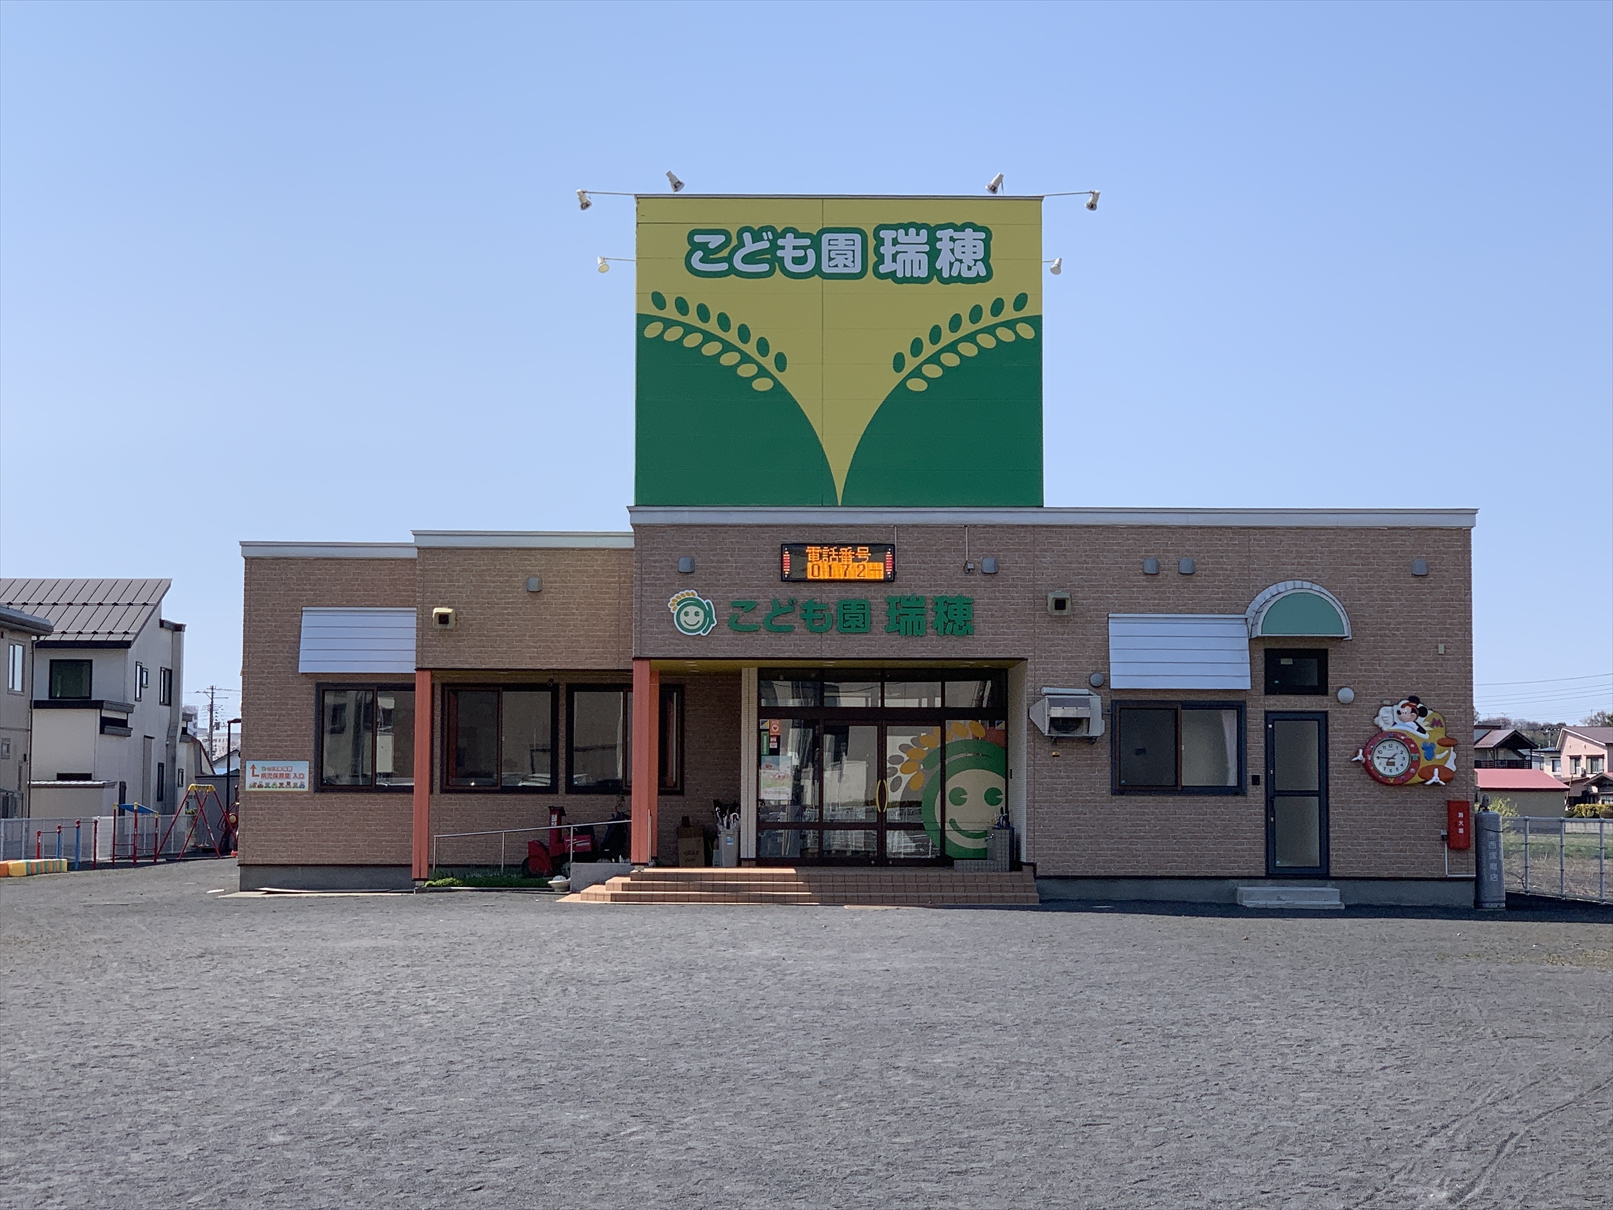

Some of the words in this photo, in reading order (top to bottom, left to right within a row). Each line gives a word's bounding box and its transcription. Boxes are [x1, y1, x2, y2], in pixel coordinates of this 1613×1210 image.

[689, 230, 863, 275] こども園
[877, 227, 988, 279] 瑞穂
[806, 546, 871, 563] 電話番号
[727, 597, 872, 634] こども園
[885, 593, 976, 637] 瑞穂
